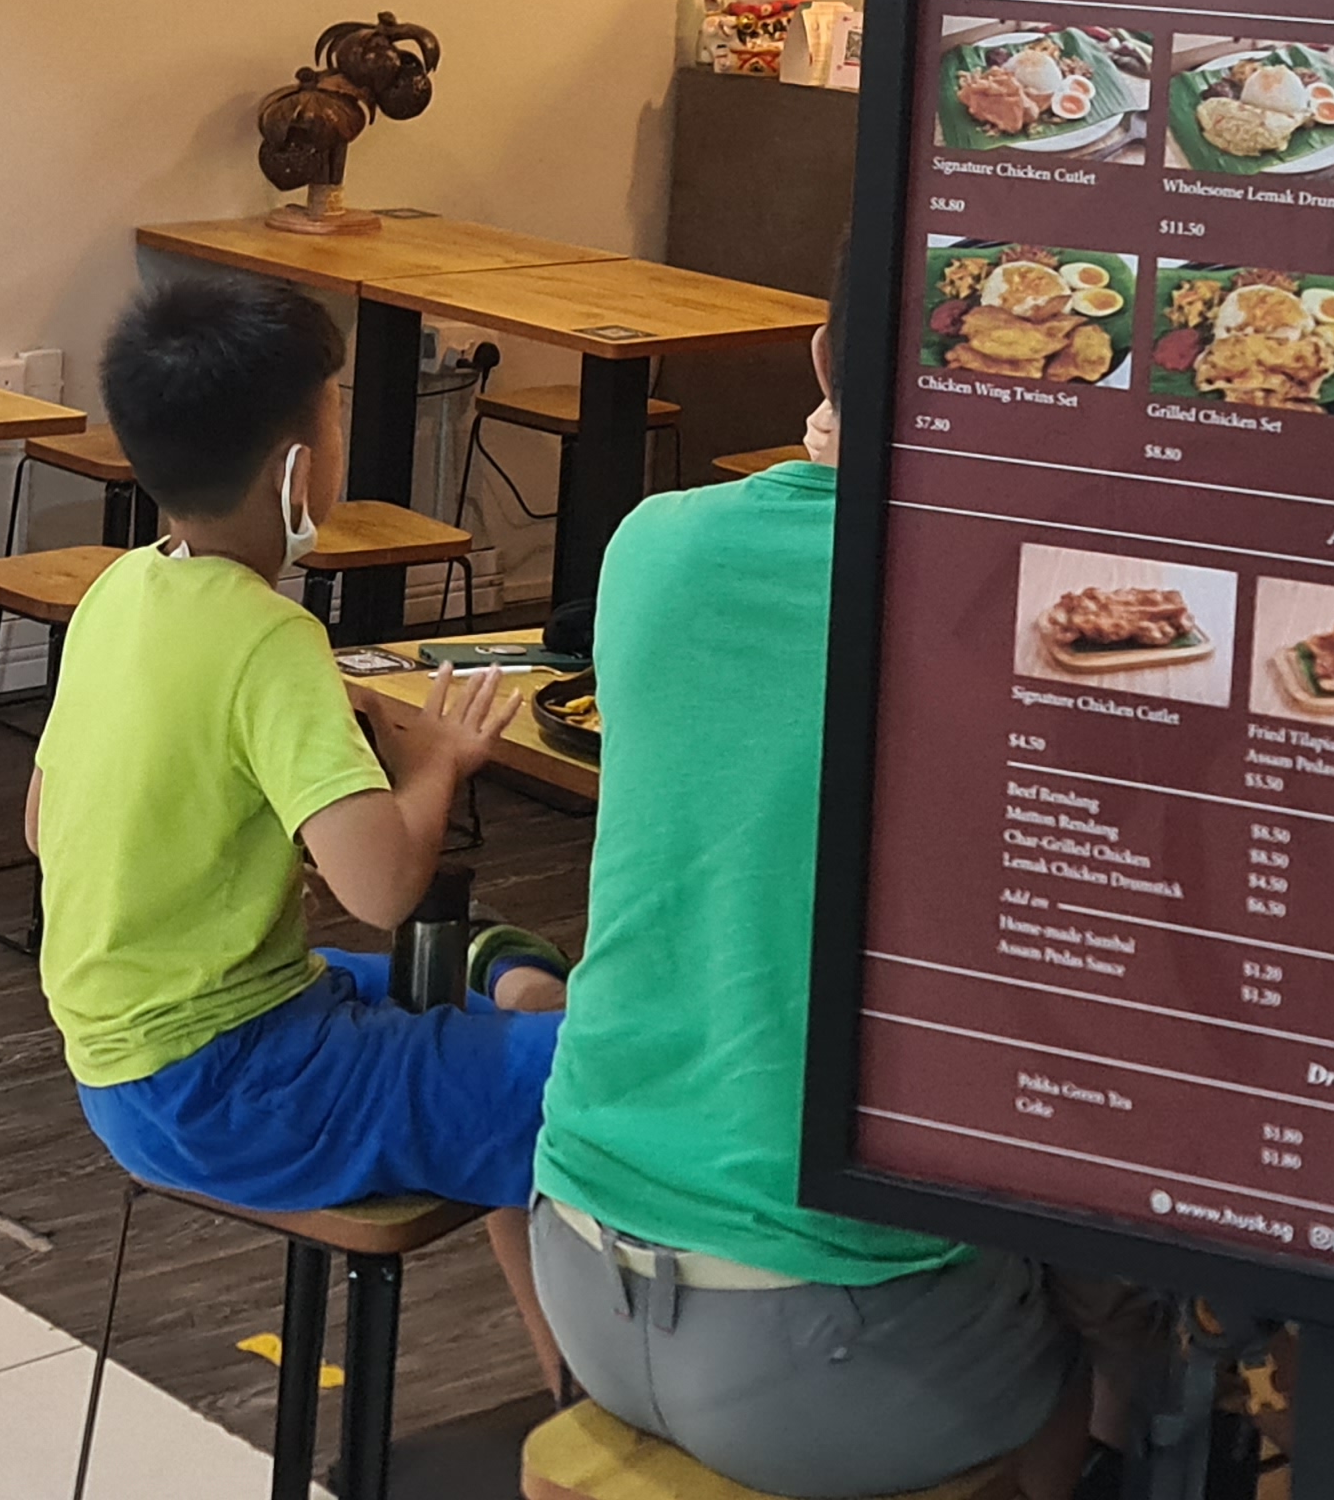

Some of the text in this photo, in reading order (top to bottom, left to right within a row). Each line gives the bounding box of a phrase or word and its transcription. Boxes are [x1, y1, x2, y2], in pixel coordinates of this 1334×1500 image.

[932, 156, 1096, 185] Signature Chicken Cutlet
[930, 196, 965, 213] $8.80
[1162, 178, 1244, 199] Wholesome
[1247, 185, 1295, 204] Lemak
[1159, 219, 1205, 237] $11.50
[917, 376, 1077, 408] Chicken Wing Twins Set
[915, 415, 950, 432] $7.80
[1147, 403, 1283, 433] Grilled Chicken Set
[1077, 695, 1134, 719] Chicken
[1136, 704, 1180, 725] Cutlet
